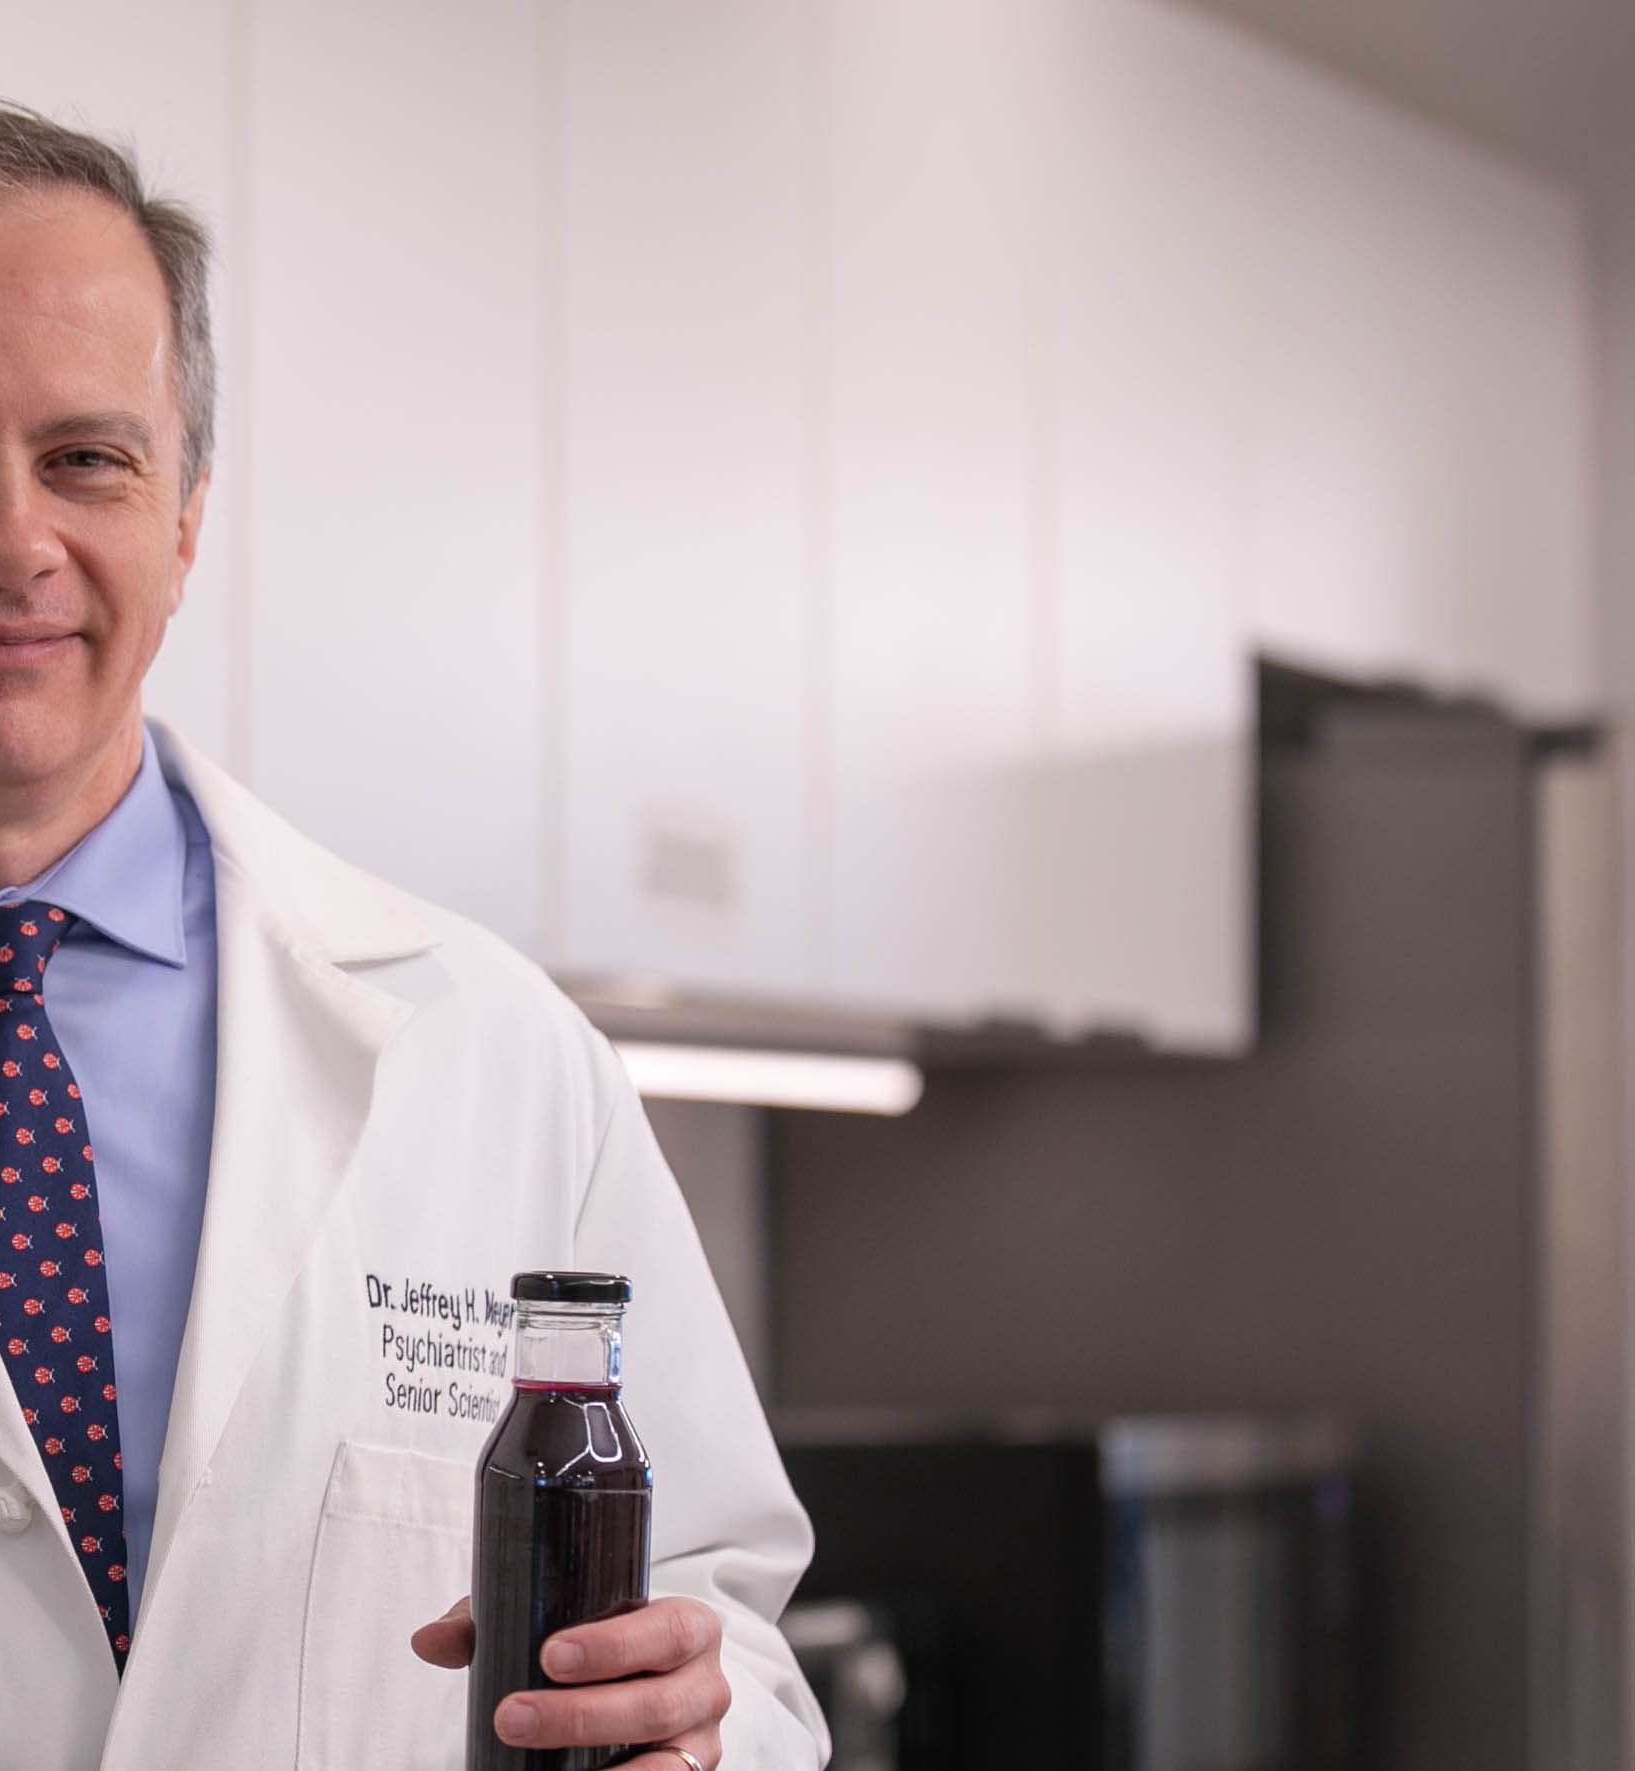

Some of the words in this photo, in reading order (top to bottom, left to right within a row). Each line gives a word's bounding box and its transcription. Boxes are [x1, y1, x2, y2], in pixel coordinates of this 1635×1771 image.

[366, 1274, 395, 1310] Dr.
[400, 1277, 462, 1331] Jeffrey
[465, 1287, 480, 1323] H.
[382, 1324, 487, 1373] Psychiatrist
[489, 1345, 508, 1379] and
[385, 1372, 442, 1415] Senior
